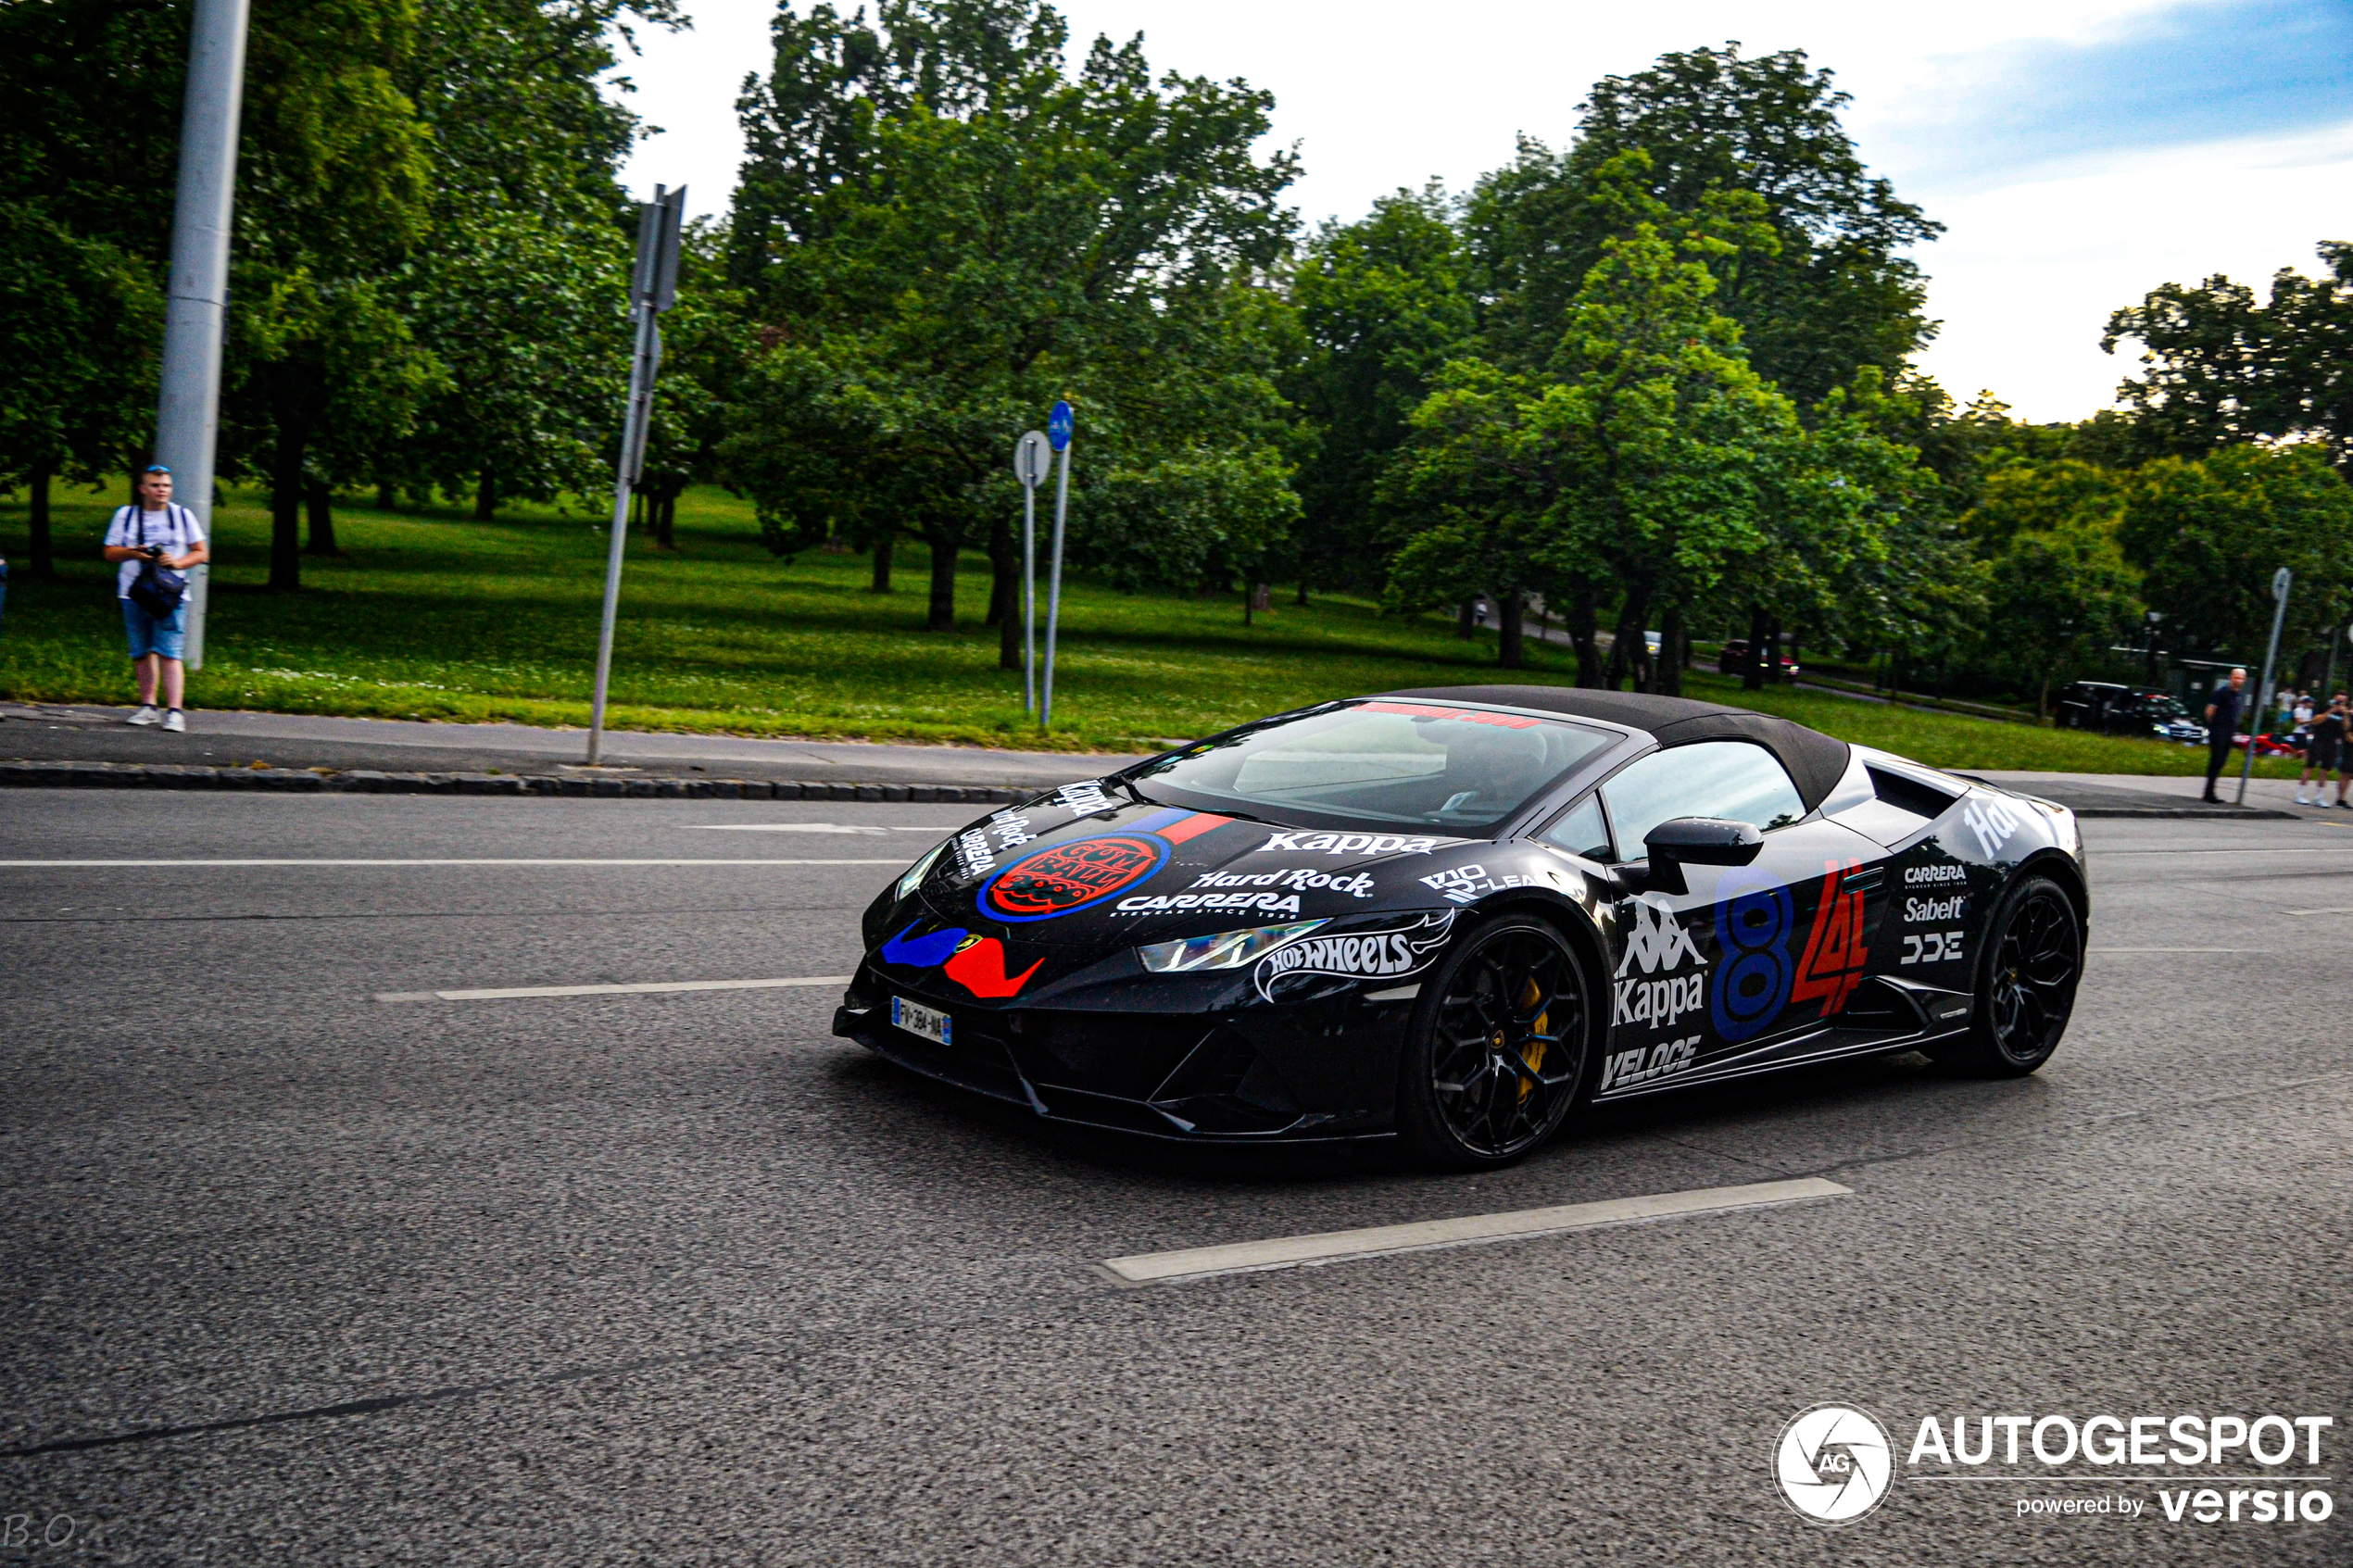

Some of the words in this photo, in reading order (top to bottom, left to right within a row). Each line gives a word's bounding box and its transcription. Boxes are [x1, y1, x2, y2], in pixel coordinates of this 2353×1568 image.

[1052, 779, 1114, 817] Kappa
[1059, 841, 1154, 871] GUM
[1255, 832, 1438, 856] Kappa
[1023, 856, 1127, 890] BALL
[1189, 869, 1290, 889] Hard
[1279, 869, 1376, 897] Rock
[1904, 863, 1967, 884] CARRERA
[1109, 908, 1184, 918] EYEWEAR
[1196, 907, 1246, 916] SINCE
[1258, 910, 1297, 920] 1956
[1115, 892, 1301, 912] CARRERA
[1904, 896, 1964, 922] Sabelt
[1710, 857, 1869, 1041] 84
[1610, 972, 1705, 1030] Kappa
[1600, 1034, 1702, 1092] VELOCE
